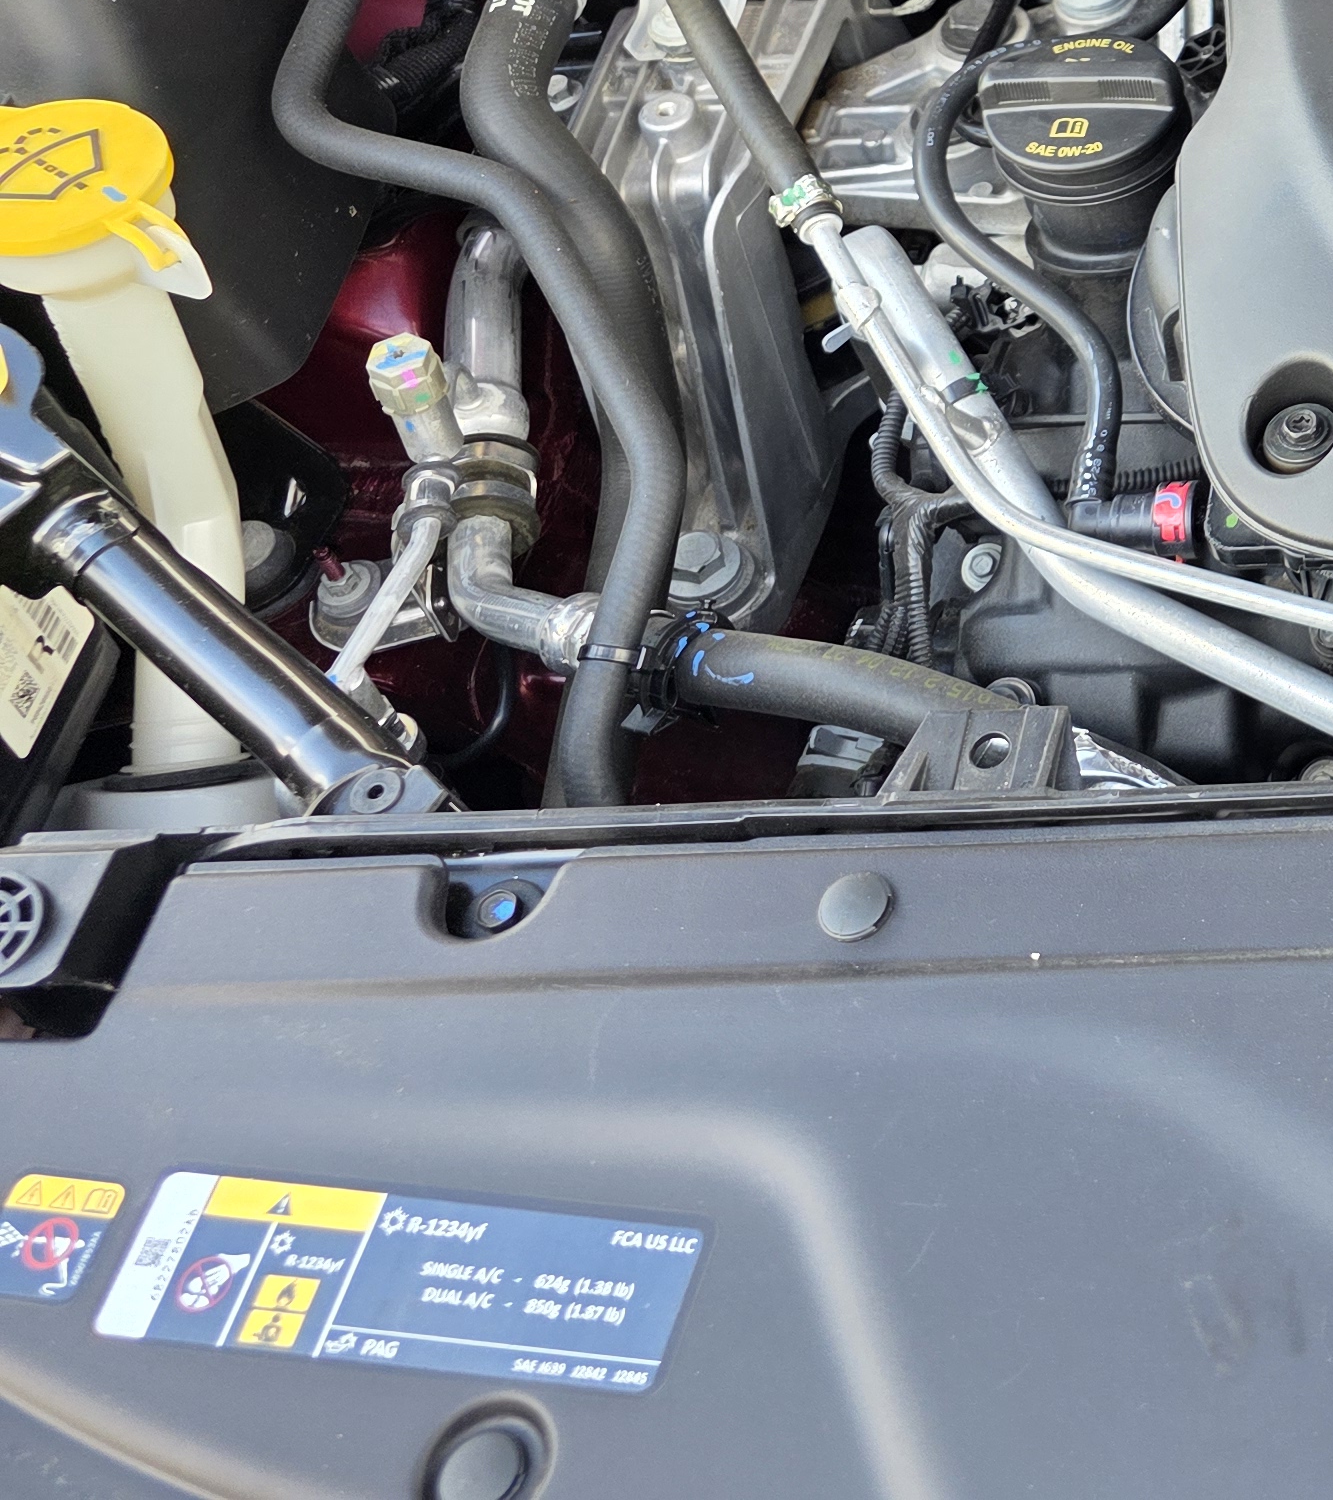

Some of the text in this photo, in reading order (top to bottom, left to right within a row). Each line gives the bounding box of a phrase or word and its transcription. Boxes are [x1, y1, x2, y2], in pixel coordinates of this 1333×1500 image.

[1052, 39, 1135, 54] ENGINE OIL
[1025, 142, 1103, 157] SAE 0W-20
[406, 1216, 488, 1243] R-1234yf
[611, 1230, 698, 1253] FCA US LLC
[420, 1262, 474, 1280] SINGLE
[472, 1267, 505, 1285] A/C
[612, 1282, 635, 1300] lb)
[421, 1287, 462, 1304] DUAL
[463, 1292, 495, 1309] A/C
[603, 1306, 626, 1326] lb)
[360, 1338, 401, 1359] PAG
[512, 1358, 538, 1373] SAE
